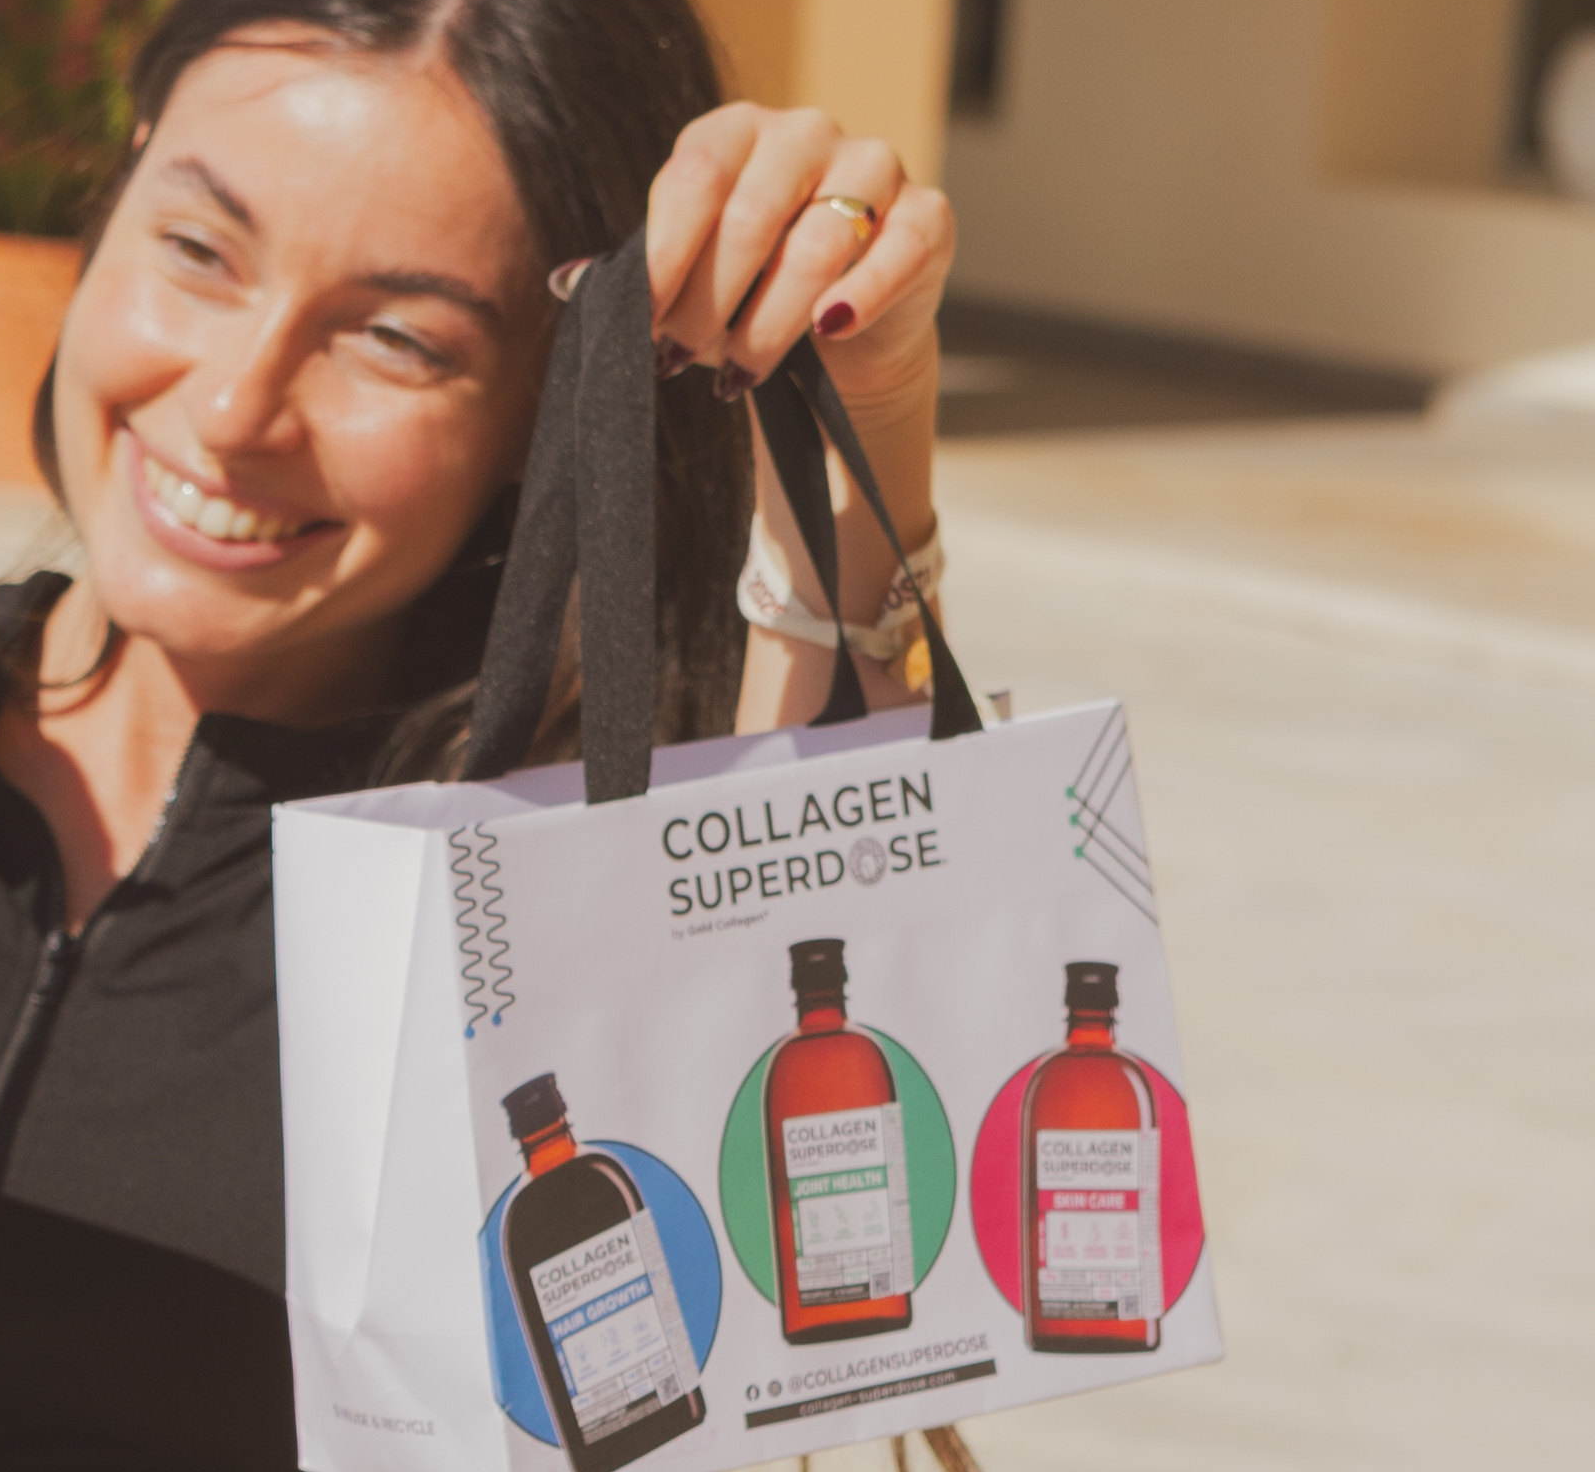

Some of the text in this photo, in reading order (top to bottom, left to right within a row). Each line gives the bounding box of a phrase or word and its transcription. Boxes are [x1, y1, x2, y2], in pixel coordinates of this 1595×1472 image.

[662, 772, 933, 860] COLLAGEN
[669, 830, 942, 915] SUPERDOSE
[788, 1119, 876, 1144] COLLAGEN
[789, 1139, 877, 1162] SUPERDOSE
[1042, 1141, 1133, 1156] COLLAGEN
[794, 1170, 883, 1197] JOINT HEALTH
[1042, 1159, 1132, 1176] SUPERDOSE
[1053, 1193, 1125, 1209] SKIN CARE
[537, 1233, 630, 1289] COLLAGEN
[542, 1251, 635, 1307] SUPERDOSE
[552, 1312, 586, 1340] HAIR
[586, 1279, 648, 1321] GROWTH
[788, 1333, 989, 1394] @COLLAGENSUPERDOSE
[799, 1369, 957, 1417] collagen-superdose.com
